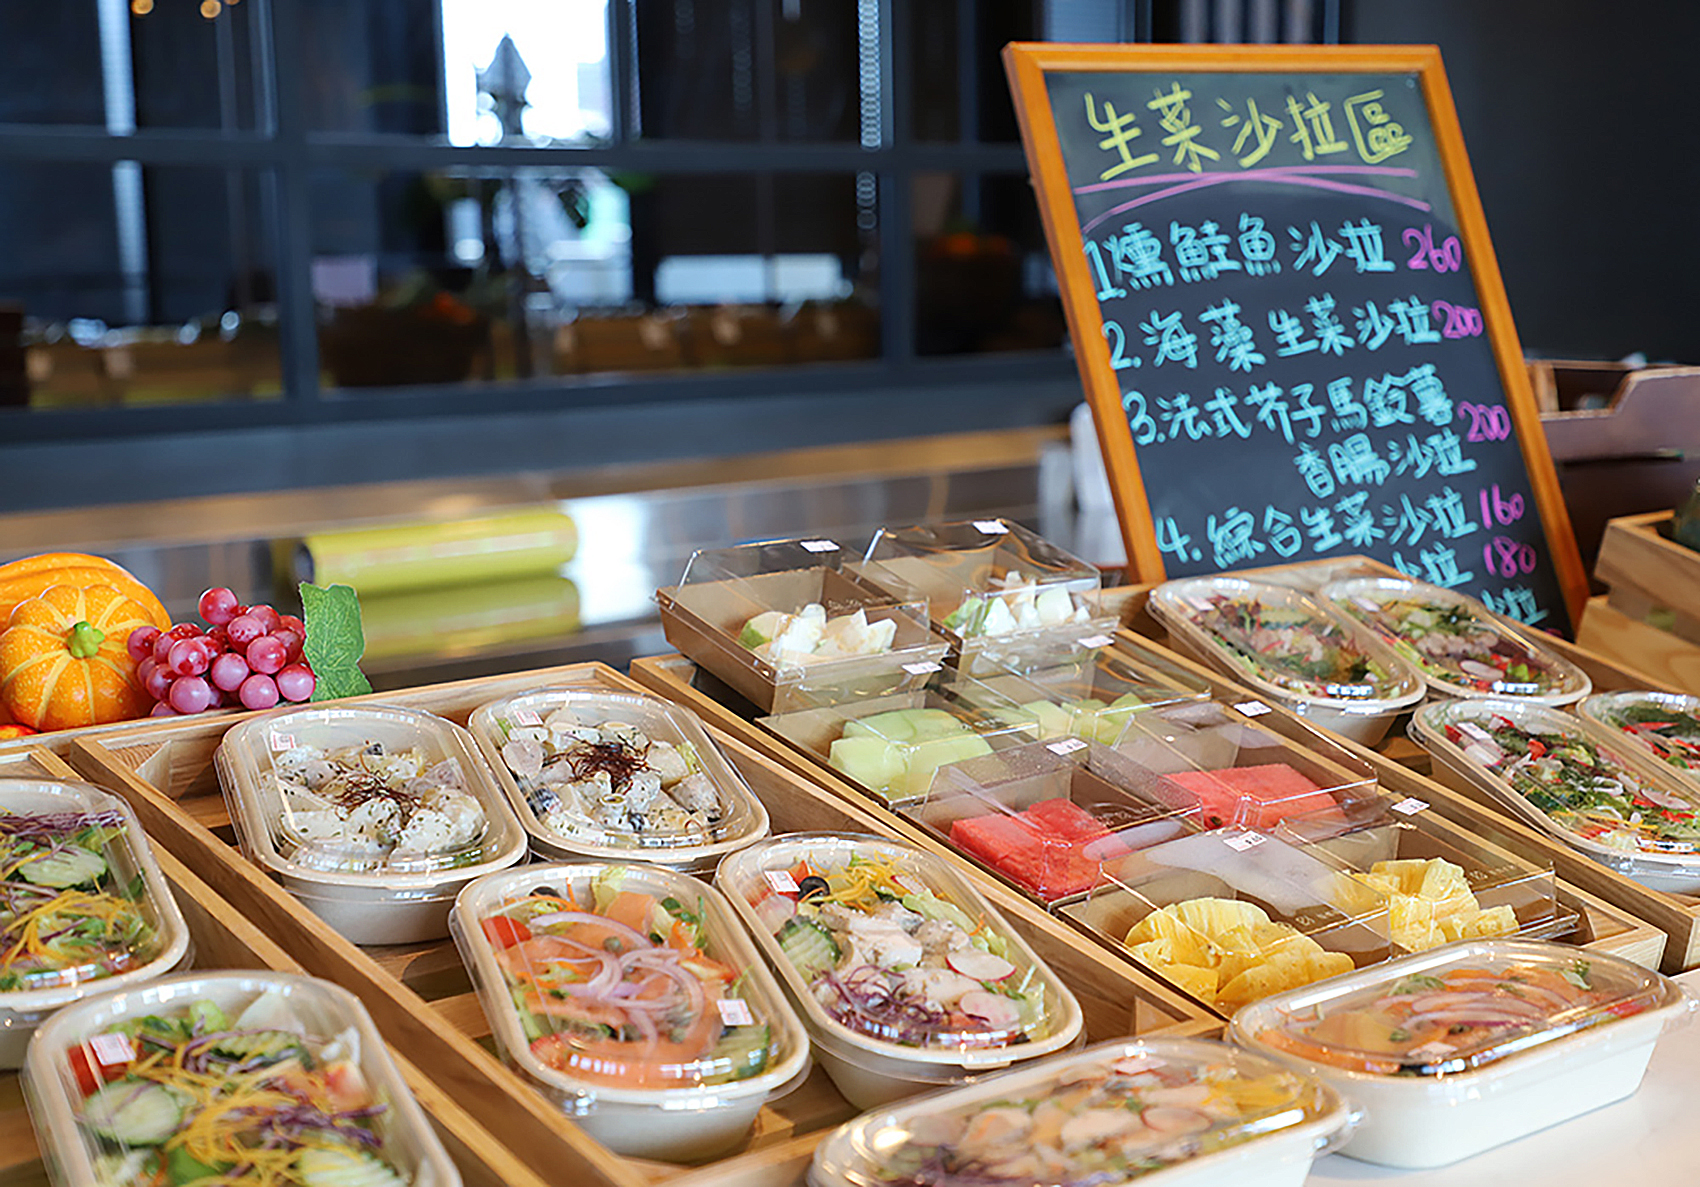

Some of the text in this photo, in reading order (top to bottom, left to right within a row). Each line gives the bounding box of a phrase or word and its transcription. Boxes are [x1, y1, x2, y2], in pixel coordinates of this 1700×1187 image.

[1086, 82, 1412, 181] 生菜沙拉區
[1403, 224, 1461, 273] 260
[1431, 300, 1482, 338] 200
[1457, 400, 1511, 442] 200
[1293, 427, 1478, 499] 香腸沙拉
[1480, 483, 1525, 530] 160
[1484, 536, 1537, 579] 180
